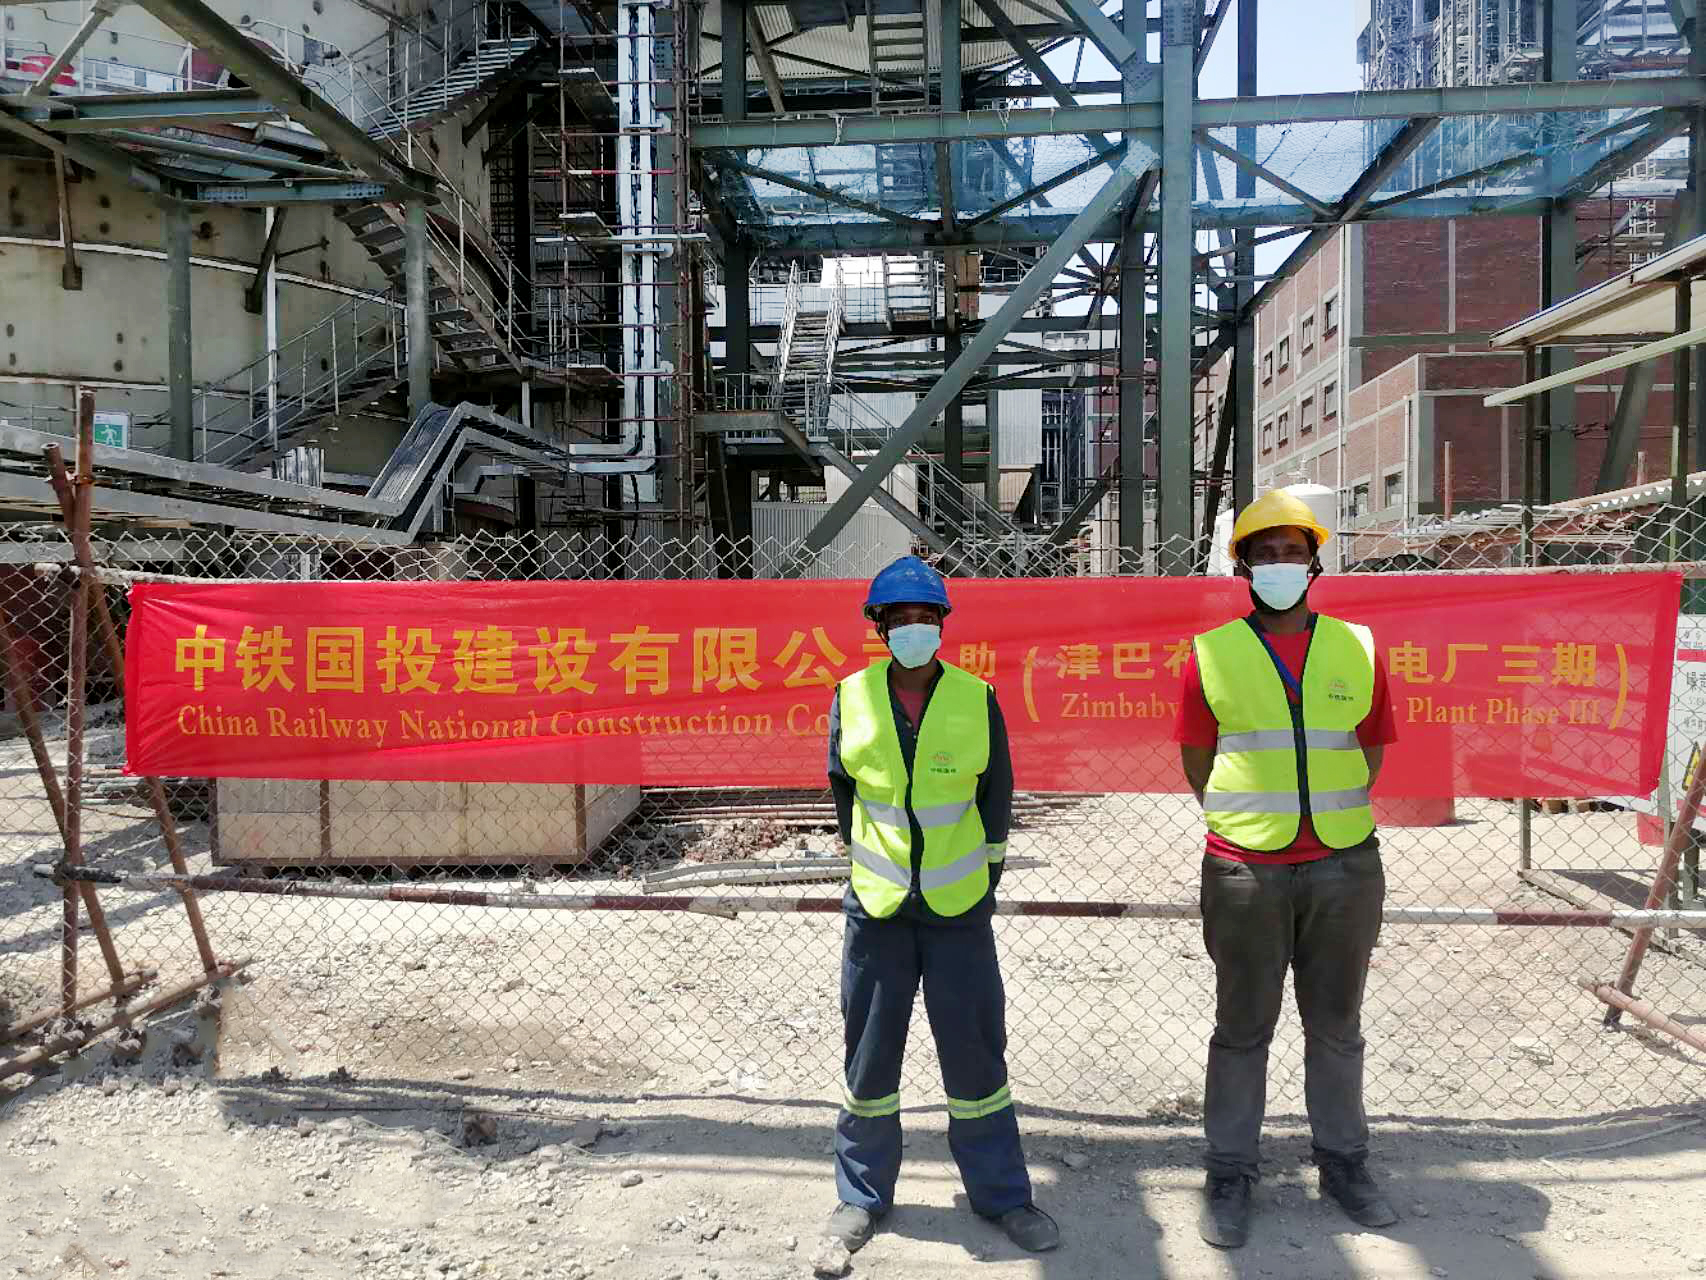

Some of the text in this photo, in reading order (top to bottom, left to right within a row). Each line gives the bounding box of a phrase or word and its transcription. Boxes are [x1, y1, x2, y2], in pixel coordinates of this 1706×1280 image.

[178, 704, 259, 737] China
[266, 707, 388, 748] Railway
[399, 709, 537, 740] National
[551, 704, 772, 737] Construction
[1407, 696, 1477, 723] Plant
[1486, 697, 1560, 724] Phase
[1567, 698, 1601, 724] III
